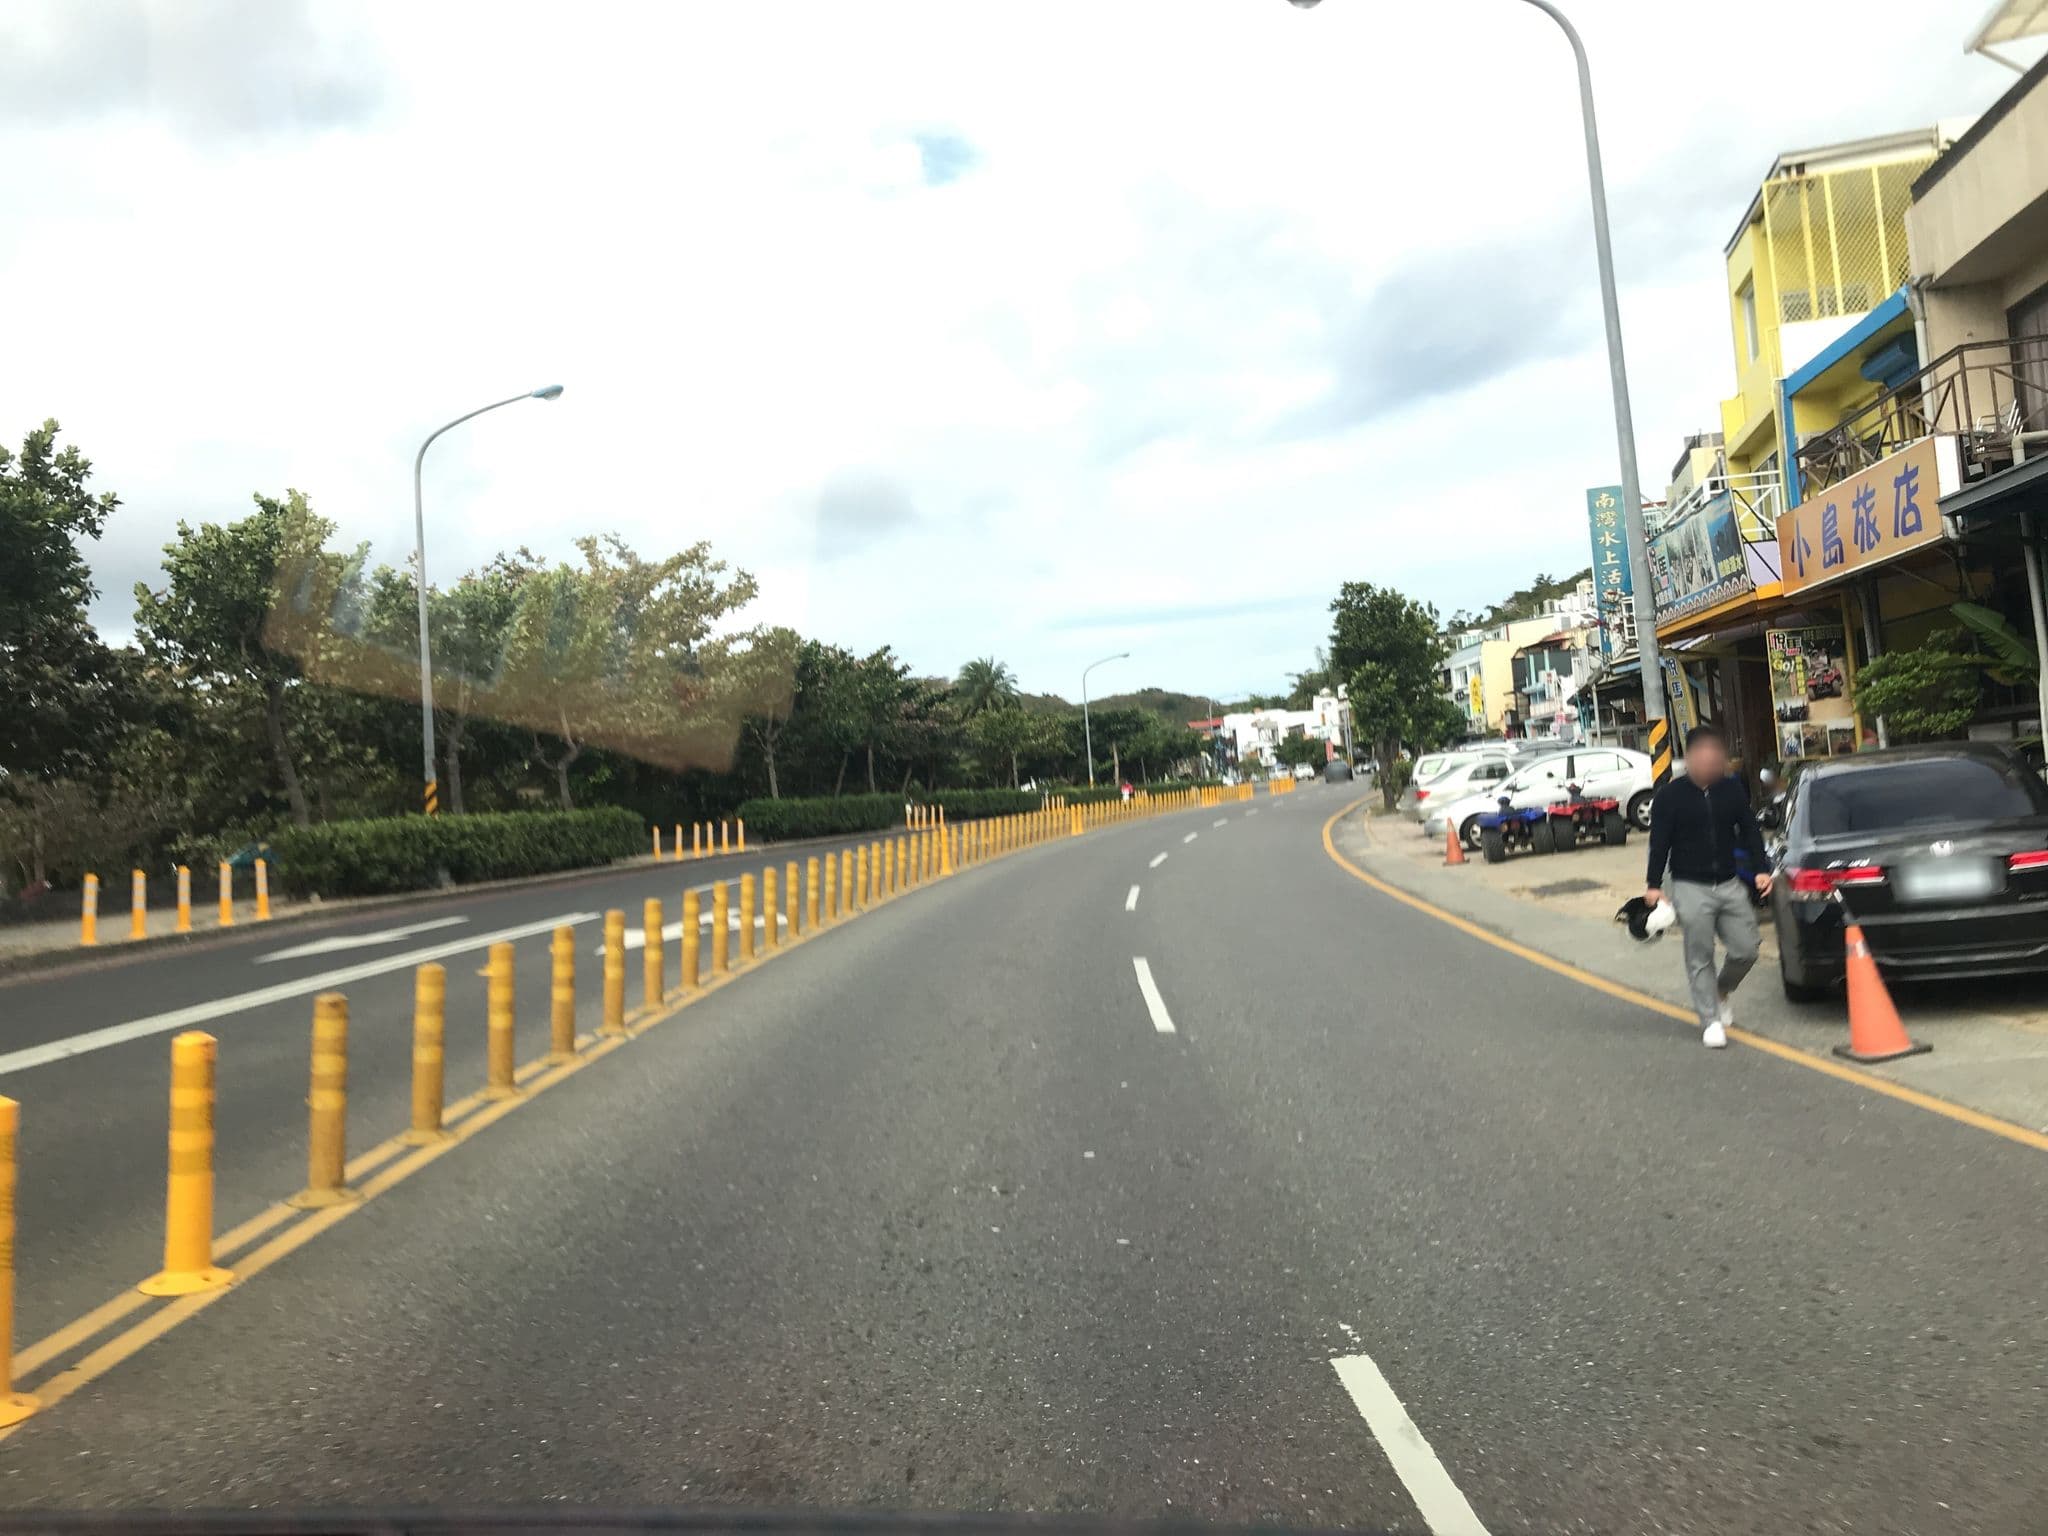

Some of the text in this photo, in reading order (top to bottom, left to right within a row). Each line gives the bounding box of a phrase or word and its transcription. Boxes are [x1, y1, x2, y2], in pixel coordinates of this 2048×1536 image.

[1594, 493, 1626, 642] 南灣水上活動
[1791, 462, 1922, 578] 小島旅店
